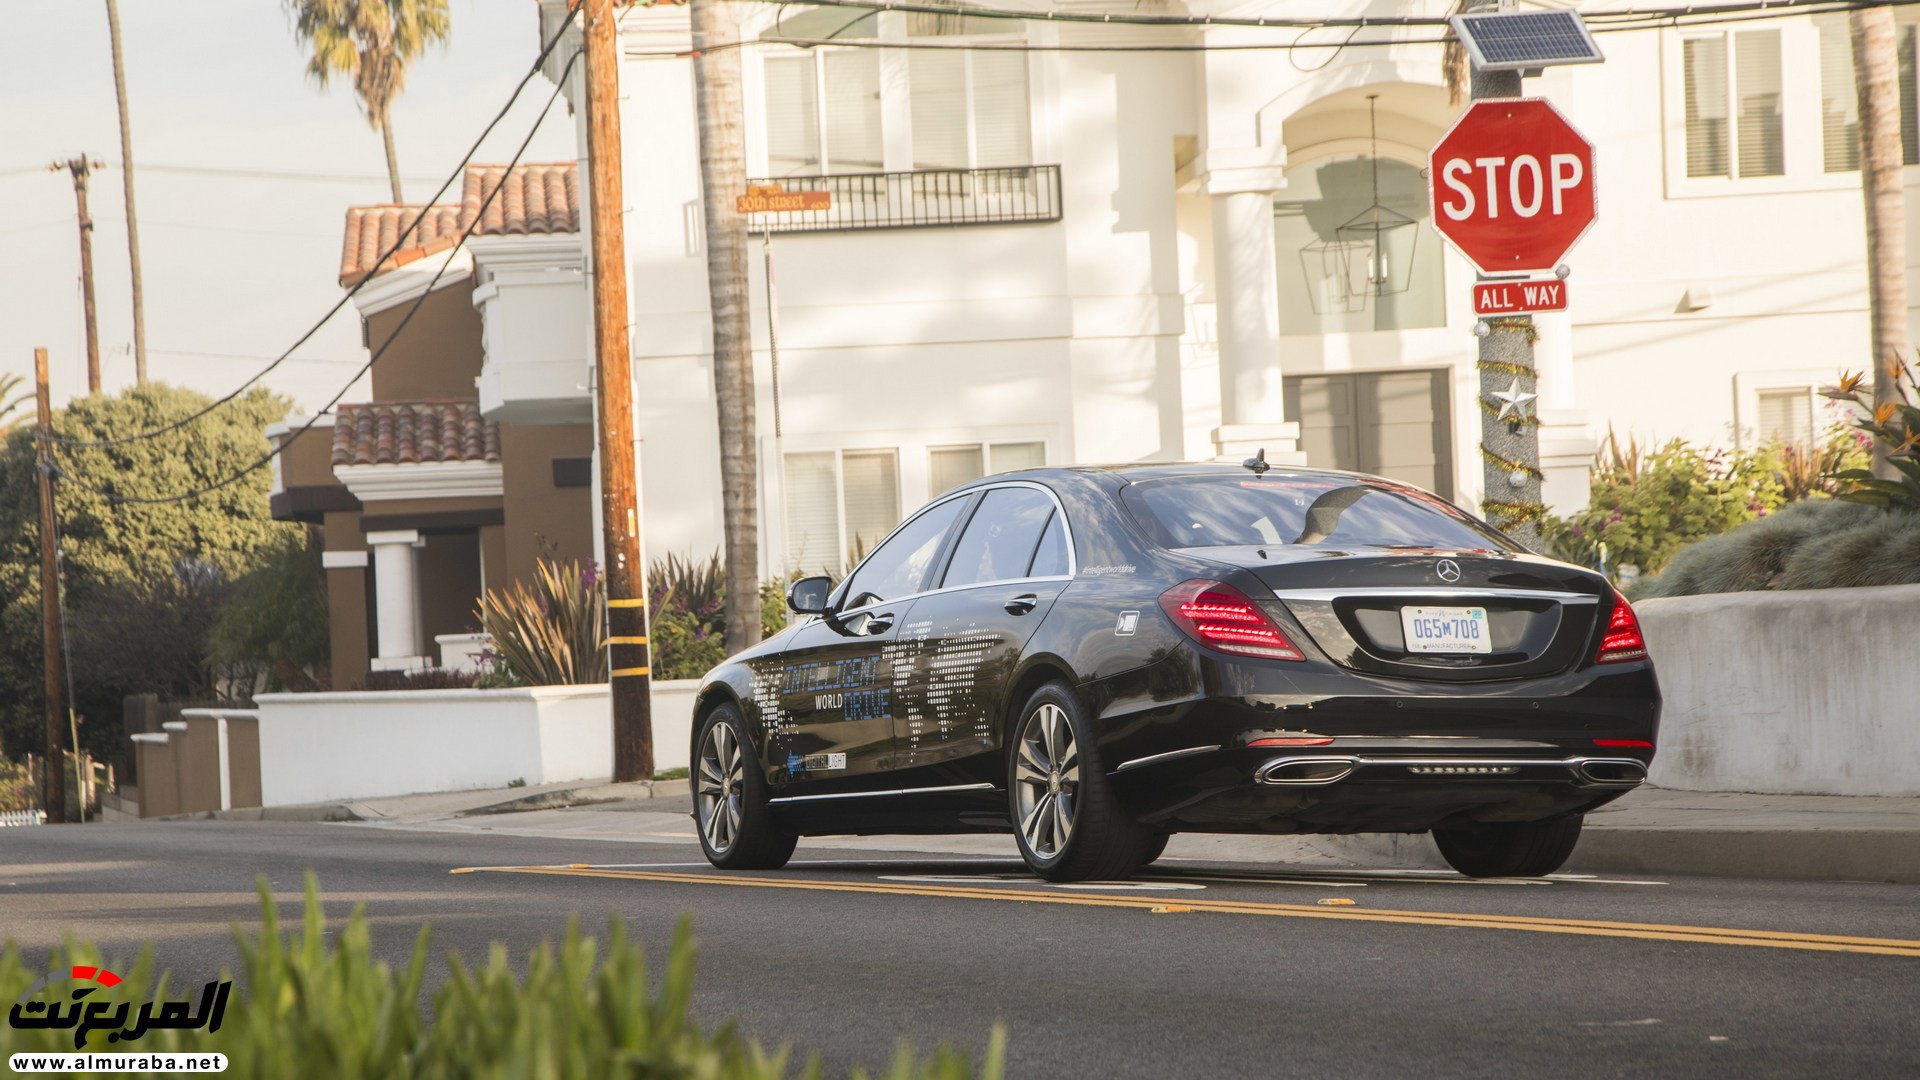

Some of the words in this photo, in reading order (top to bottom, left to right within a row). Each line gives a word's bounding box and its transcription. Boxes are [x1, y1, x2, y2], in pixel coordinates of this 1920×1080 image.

[1443, 154, 1583, 220] STOP
[1481, 289, 1513, 308] ALL
[1524, 285, 1559, 305] WAY
[1414, 619, 1479, 639] 065M708
[783, 656, 880, 694] INTELLIGENT
[815, 693, 843, 710] WORLD
[844, 689, 891, 720] DRIVE
